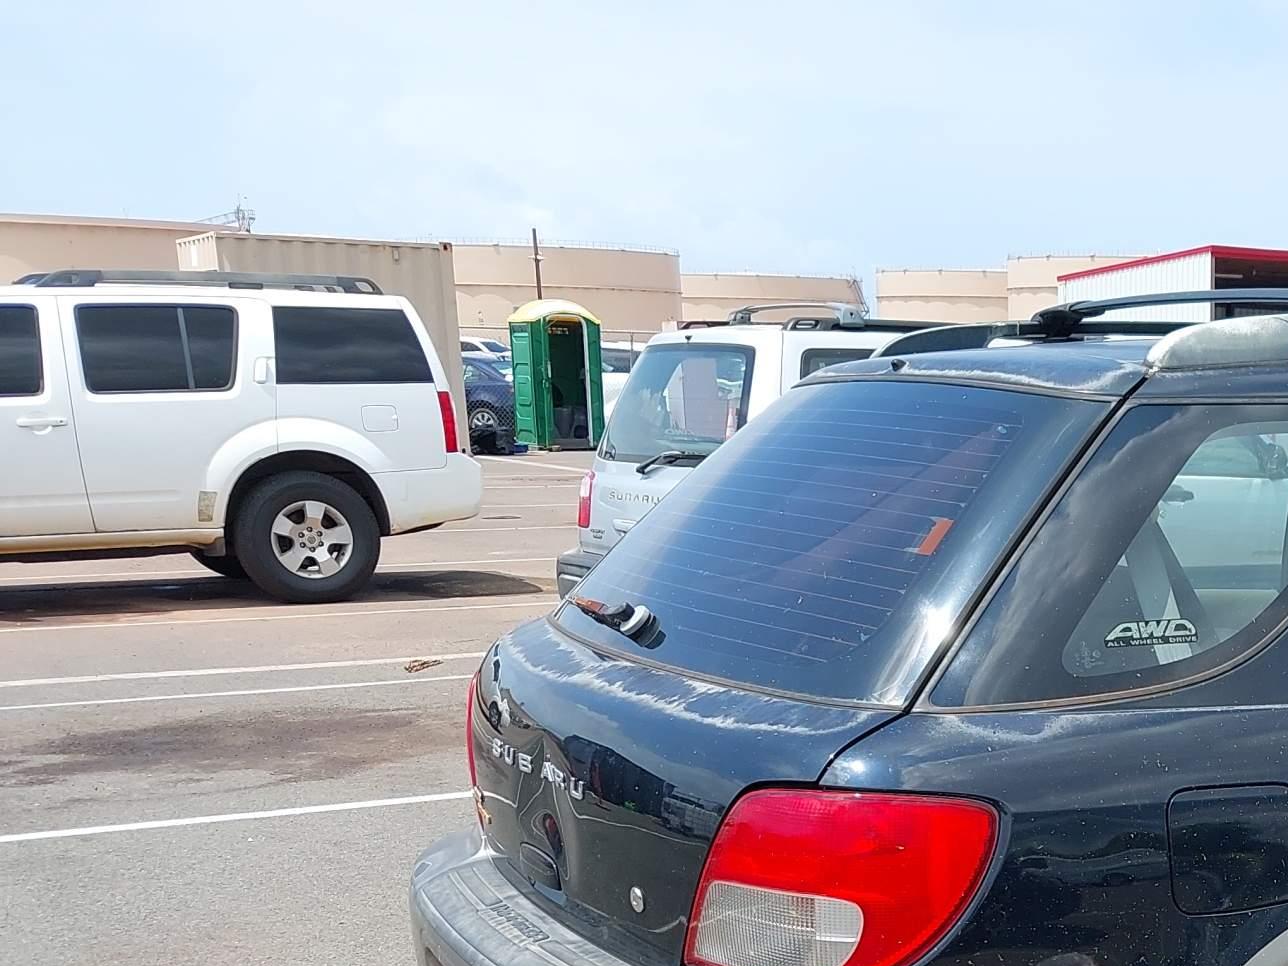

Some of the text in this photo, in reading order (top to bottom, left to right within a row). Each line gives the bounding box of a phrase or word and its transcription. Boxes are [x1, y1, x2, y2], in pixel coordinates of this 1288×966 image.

[1104, 619, 1197, 641] AWD
[1107, 635, 1197, 648] ALL WHEEL DRIVE
[492, 737, 585, 801] SUBARU
